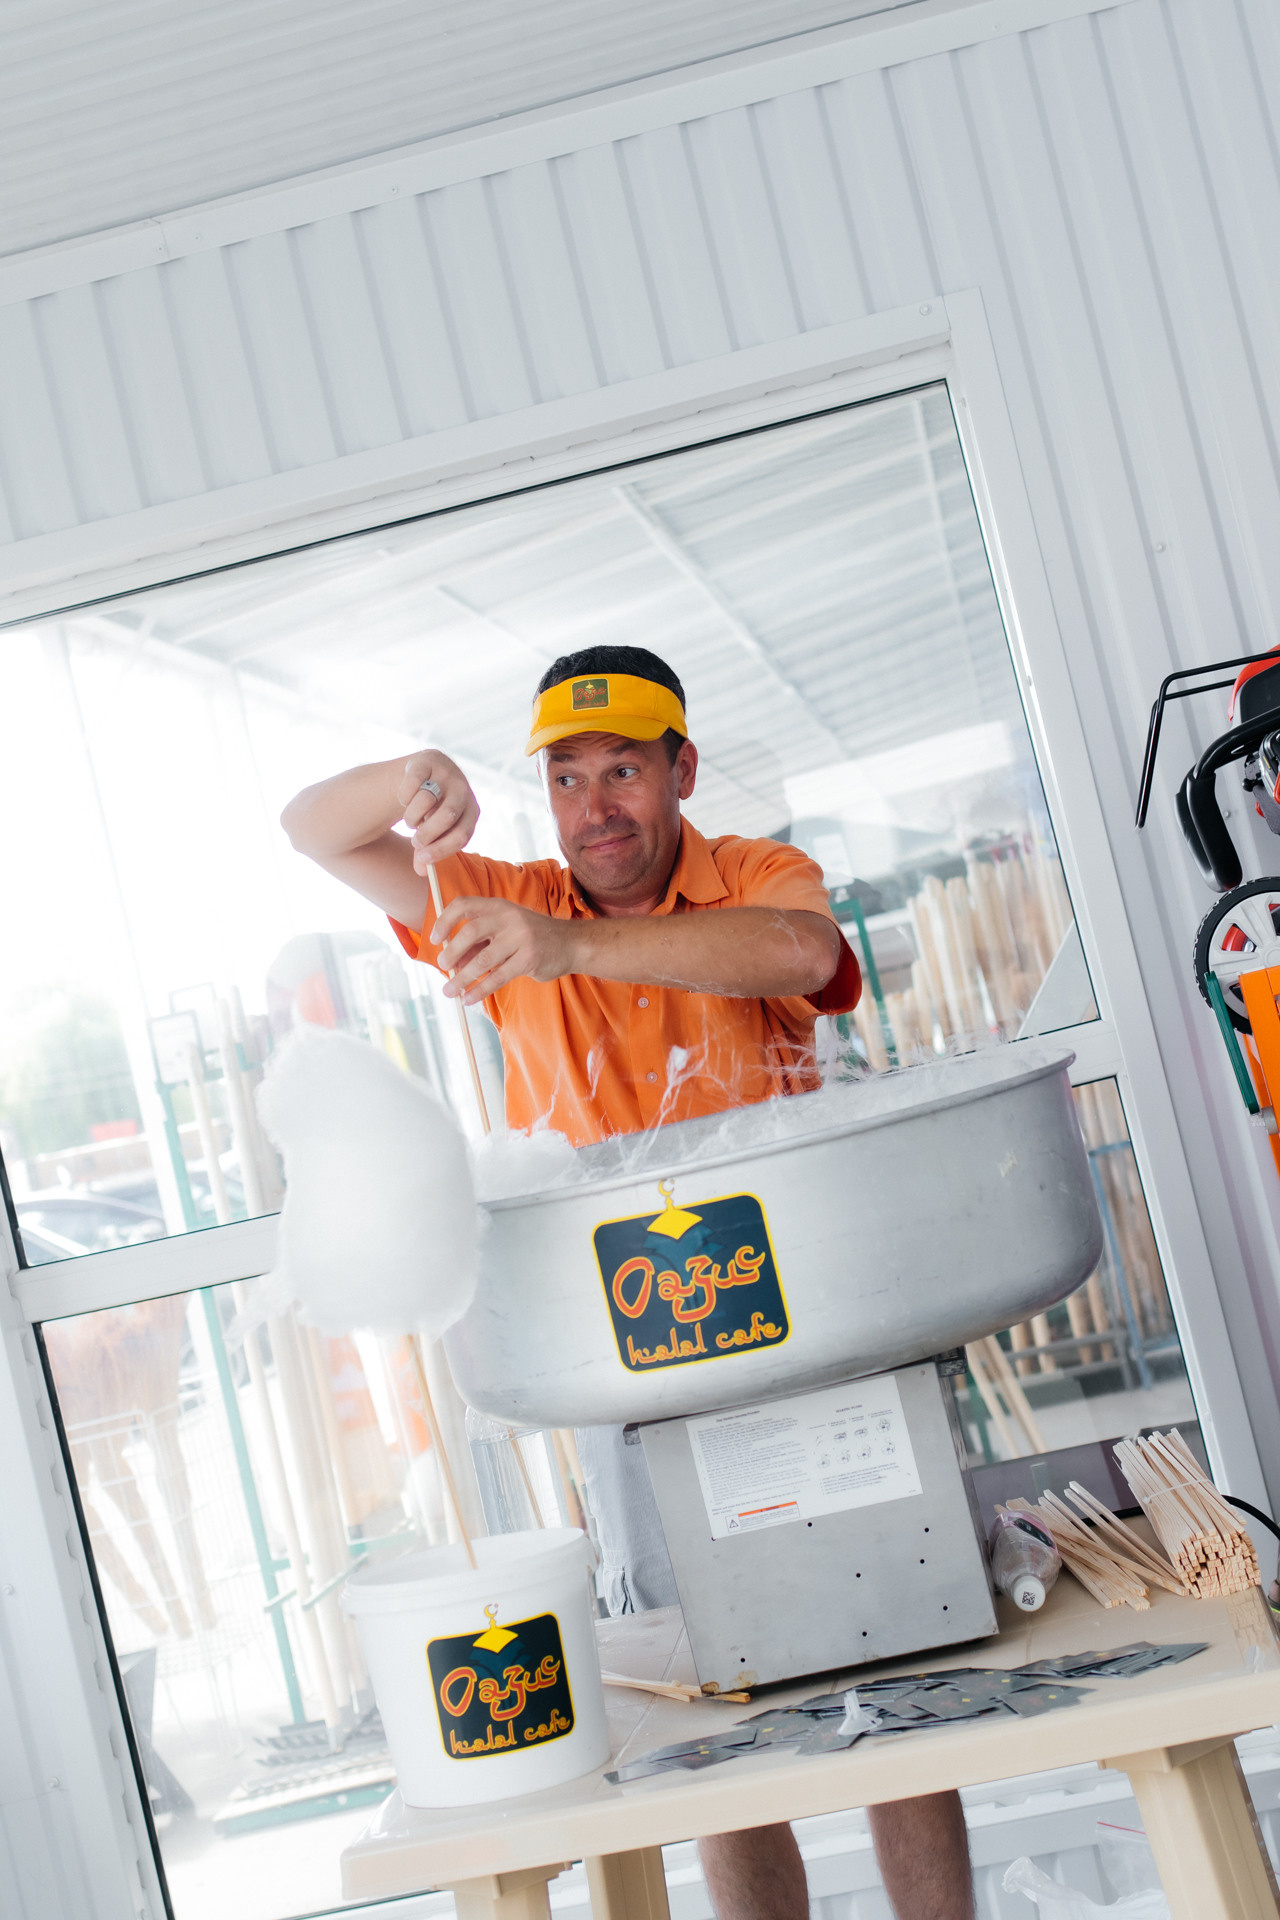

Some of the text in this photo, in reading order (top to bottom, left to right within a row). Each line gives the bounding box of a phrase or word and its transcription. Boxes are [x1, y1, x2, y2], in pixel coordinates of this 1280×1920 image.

[627, 1312, 782, 1366] halal cafe
[450, 1708, 570, 1755] halal cafe
